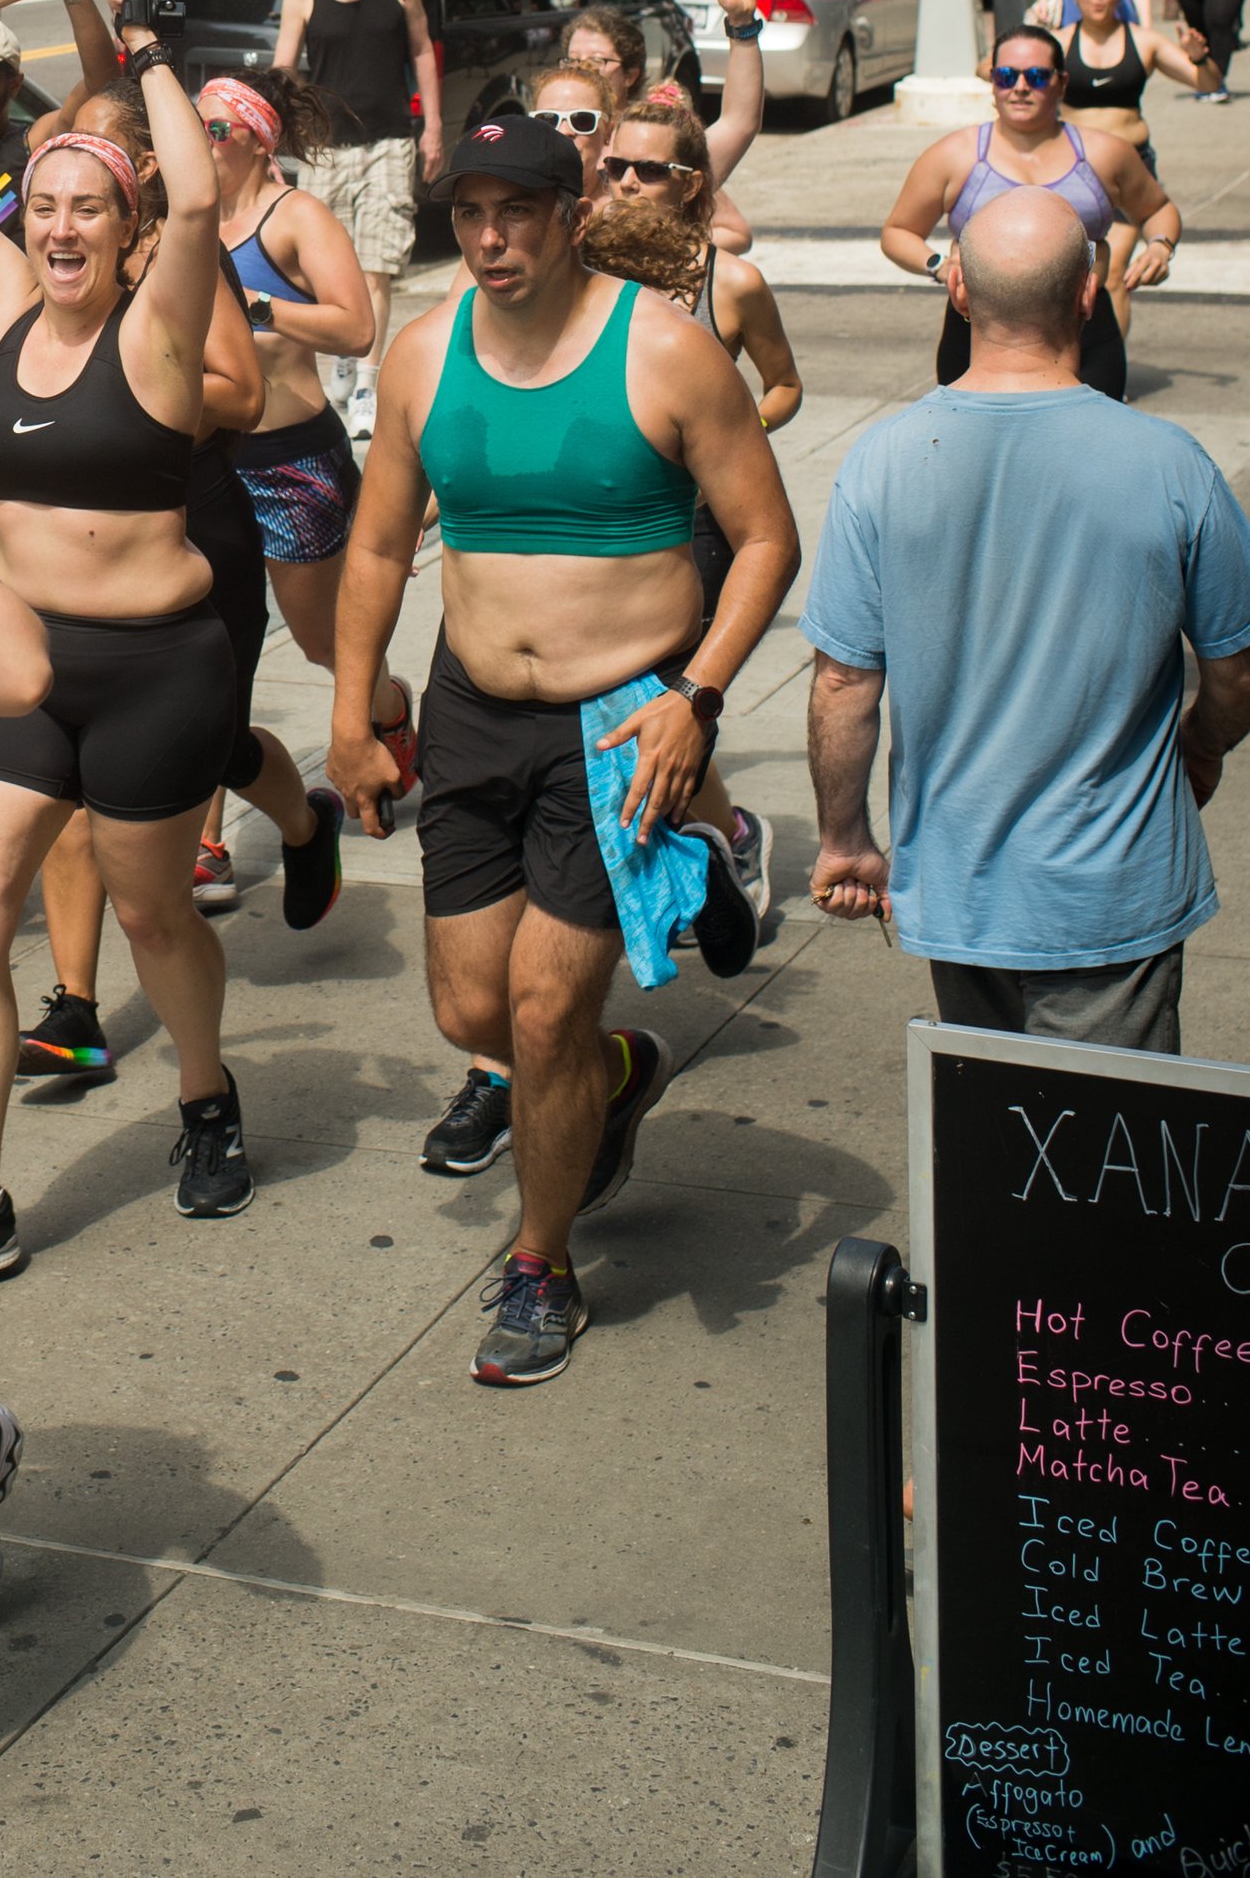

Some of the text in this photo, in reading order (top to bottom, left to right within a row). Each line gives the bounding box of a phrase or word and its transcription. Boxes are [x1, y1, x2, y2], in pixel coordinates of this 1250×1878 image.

[1016, 1299, 1250, 1373] Hot Coffee
[1017, 1350, 1192, 1404] Espresso
[1019, 1398, 1131, 1444] Latte
[1016, 1442, 1231, 1507] Matcha Tea
[1018, 1495, 1118, 1544] Iced
[1021, 1538, 1242, 1605] Cold Brew
[1021, 1584, 1246, 1655] Iced Latte
[1024, 1635, 1206, 1700] Iced Tea
[1027, 1678, 1186, 1742] Homemade
[957, 1733, 1060, 1770] Dessert
[962, 1772, 1084, 1815] Affogato
[1131, 1813, 1177, 1859] and
